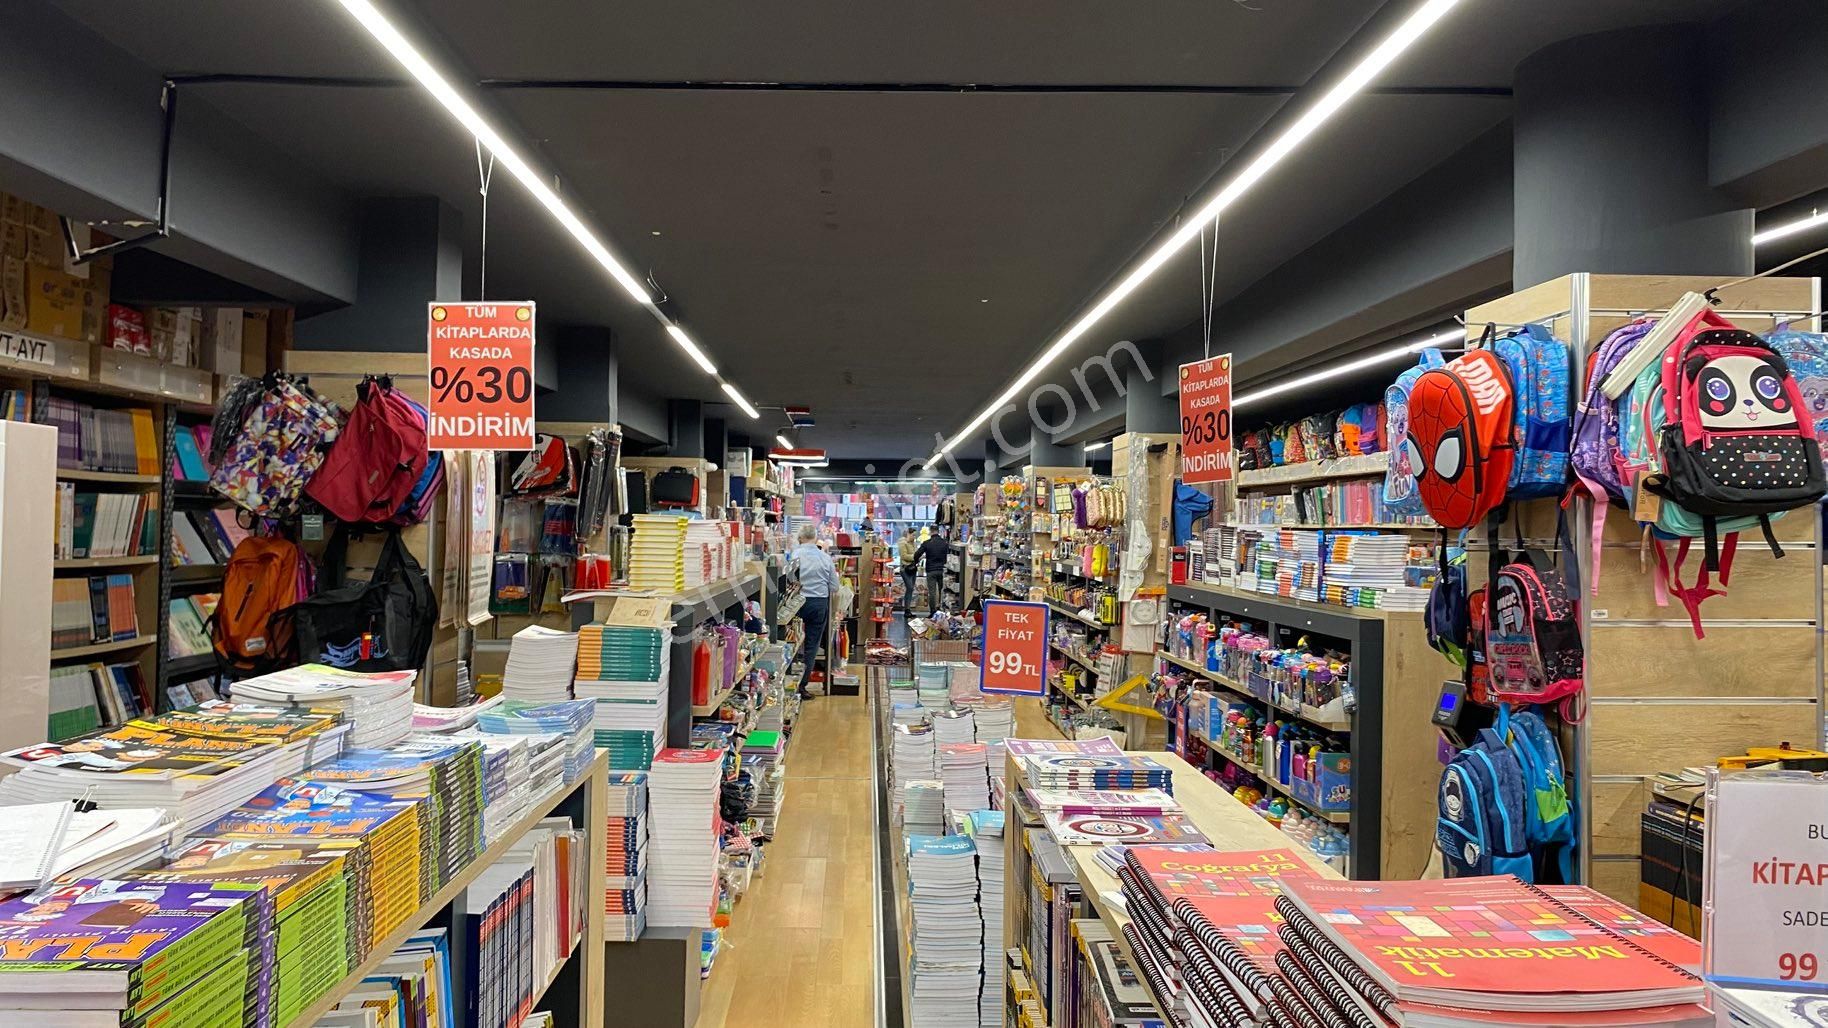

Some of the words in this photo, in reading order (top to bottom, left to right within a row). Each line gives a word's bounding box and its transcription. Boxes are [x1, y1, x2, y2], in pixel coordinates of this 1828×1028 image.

[465, 304, 497, 318] TÜM
[436, 325, 531, 339] KİTAPLARDA
[450, 347, 513, 360] KASADA
[430, 366, 532, 404] %30
[1183, 374, 1229, 394] KİTAPLARDA
[1190, 394, 1221, 409] KASADA
[430, 411, 533, 437] İNDİRİM
[1182, 408, 1230, 446] %30
[1182, 449, 1232, 473] İNDİRİM
[1004, 612, 1029, 624] TEK
[998, 627, 1034, 641] FİYAT
[1257, 853, 1290, 862] 11
[1160, 861, 1300, 874] Coğrafya
[1374, 944, 1630, 960] Matematik
[1392, 960, 1456, 977] 11
[1778, 952, 1818, 981] 99
